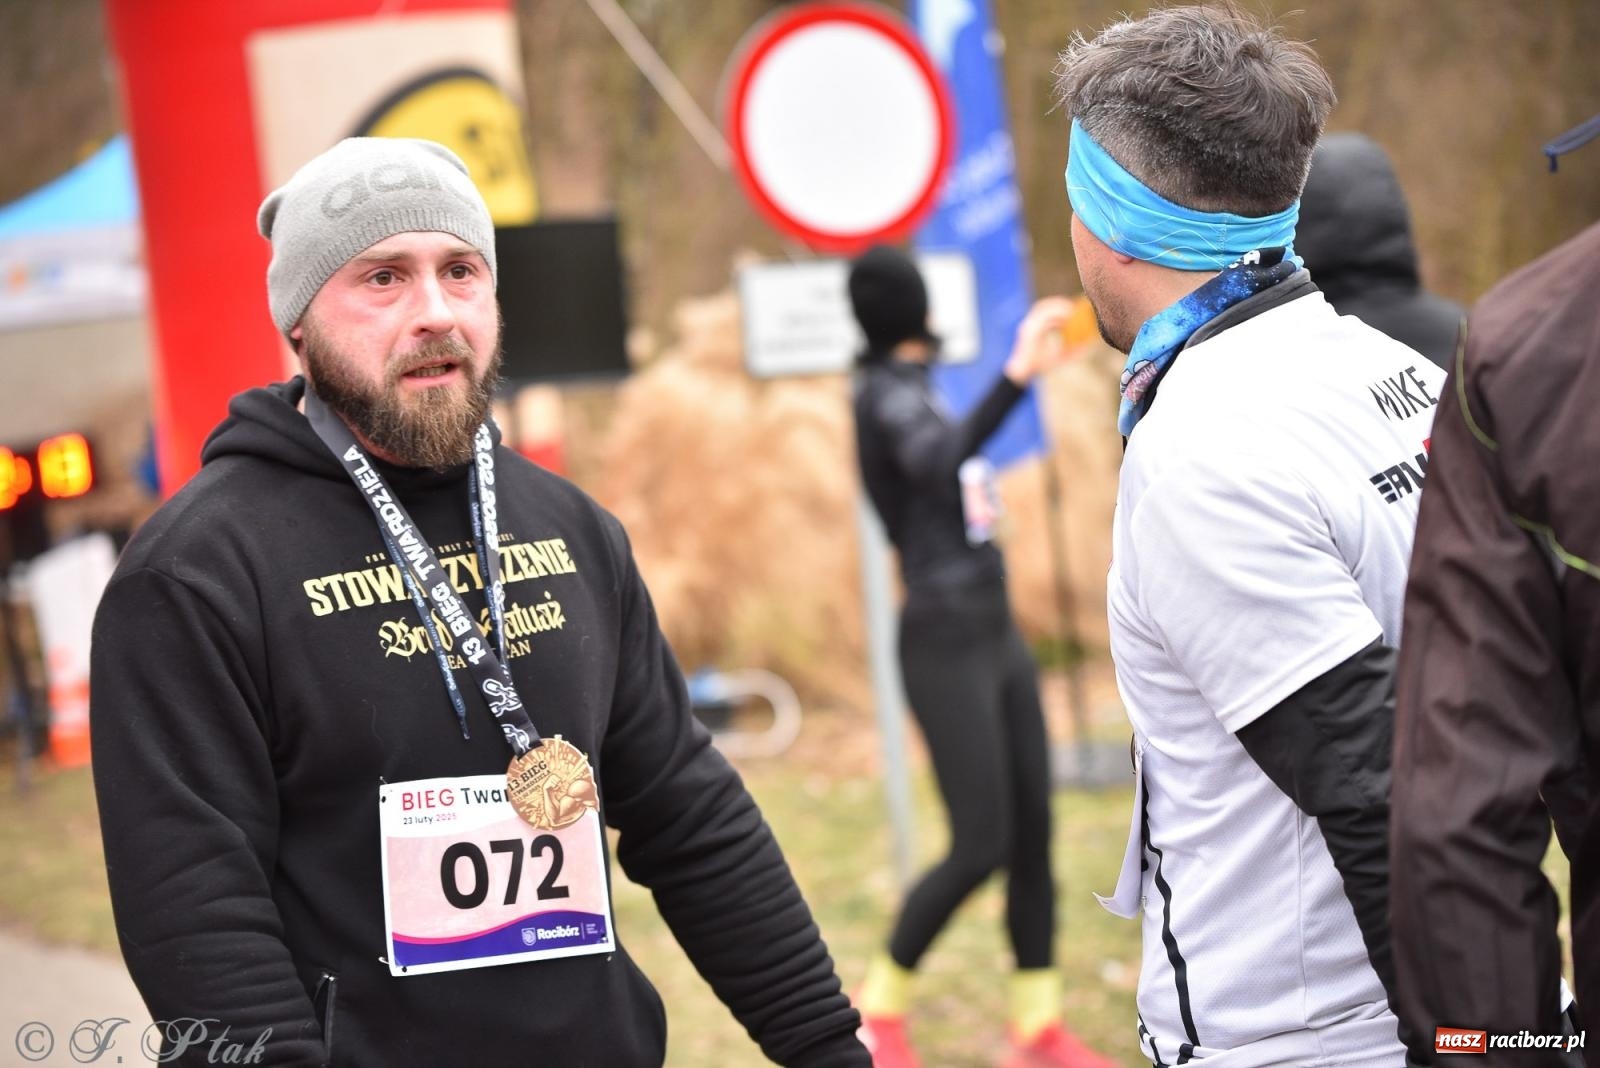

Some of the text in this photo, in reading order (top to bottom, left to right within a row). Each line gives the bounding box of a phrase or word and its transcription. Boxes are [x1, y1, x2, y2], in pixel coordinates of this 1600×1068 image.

[1367, 366, 1439, 421] MIKE
[343, 444, 436, 581] TWARDZIELA
[303, 538, 577, 617] STOWZYZENIE
[432, 582, 472, 637] BIEG
[462, 637, 487, 665] 13
[507, 760, 548, 791] 13 BIEG
[402, 788, 455, 811] BIEG
[403, 817, 413, 825] 23
[440, 834, 570, 910] 072
[536, 925, 580, 940] Racibórz
